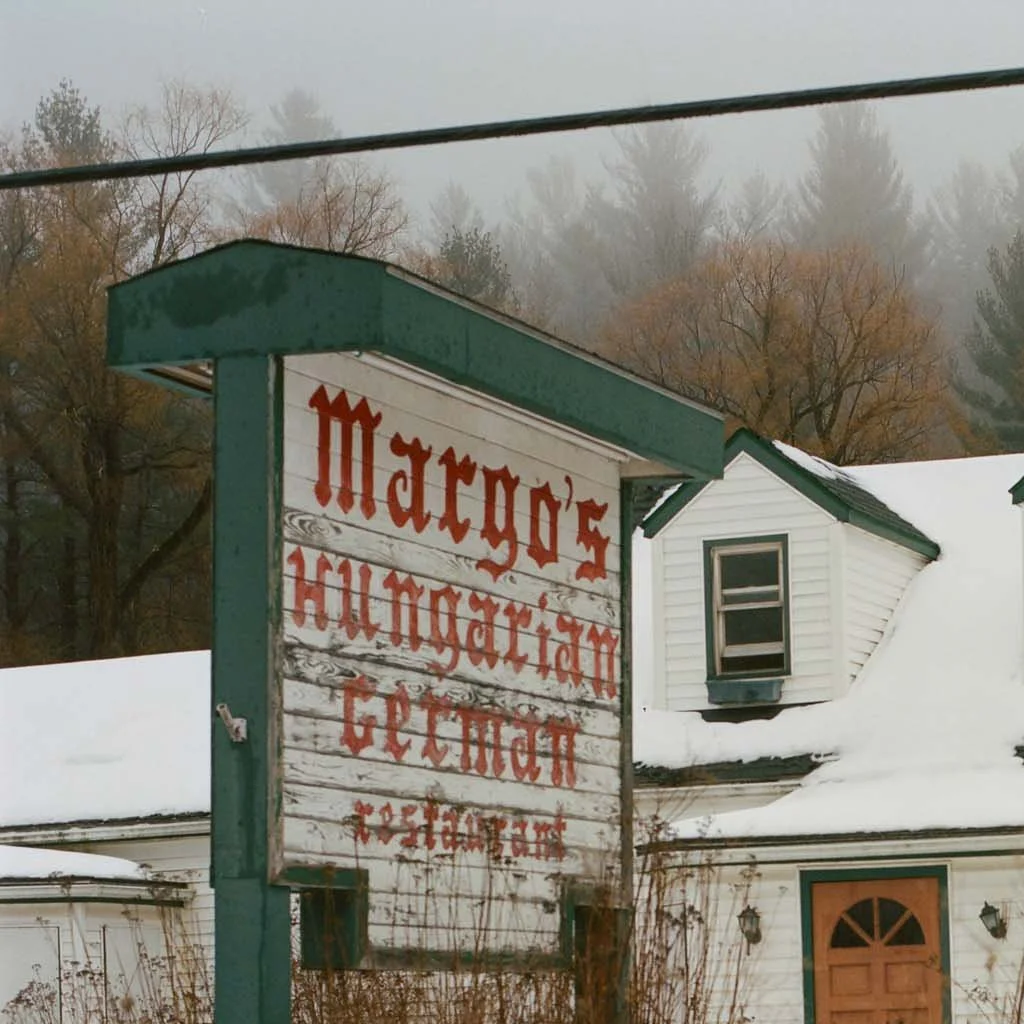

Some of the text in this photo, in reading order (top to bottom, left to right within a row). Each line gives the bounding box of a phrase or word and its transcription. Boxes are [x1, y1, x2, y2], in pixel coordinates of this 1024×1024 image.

[308, 384, 610, 583] Margo's
[287, 545, 619, 699] Hungarian
[339, 674, 580, 788] German
[354, 794, 567, 862] restaurant
